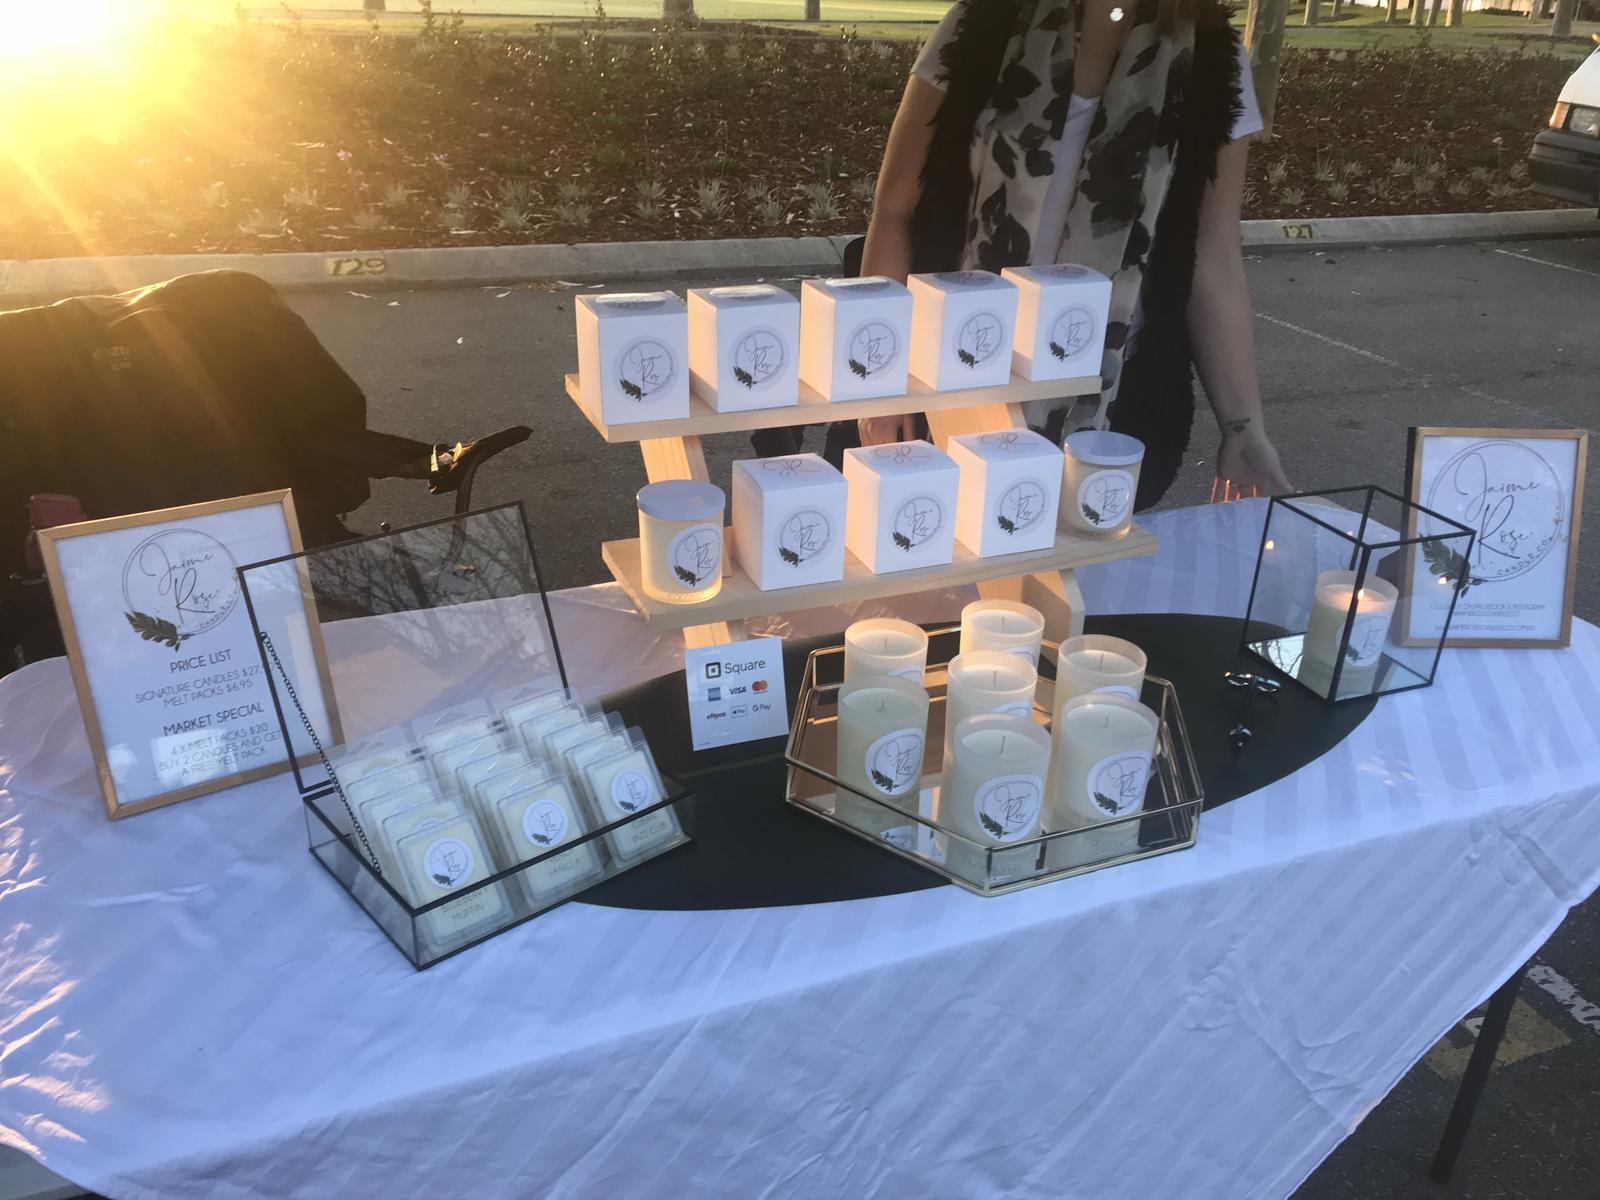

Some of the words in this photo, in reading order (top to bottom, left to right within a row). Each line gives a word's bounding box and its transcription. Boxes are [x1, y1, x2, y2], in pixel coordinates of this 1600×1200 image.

[1281, 224, 1313, 239] 127
[329, 257, 386, 276] 129
[1455, 452, 1540, 522] Jaime
[170, 655, 206, 673] PRICE
[209, 649, 231, 664] LIST
[724, 660, 766, 675] Square
[134, 681, 191, 704] SIGNATURE
[193, 670, 240, 689] CANDLES
[163, 694, 188, 708] MELT
[191, 687, 223, 701] PACKS
[226, 678, 253, 692] $6.95
[729, 686, 747, 695] VISA
[163, 714, 212, 736] MARKET
[216, 702, 265, 723] SPECIAL
[188, 736, 211, 751] MELT
[214, 729, 247, 743] PACKS
[249, 723, 269, 735] $20
[191, 745, 239, 762] CANDLES
[240, 737, 263, 750] AND
[241, 746, 266, 759] PACK
